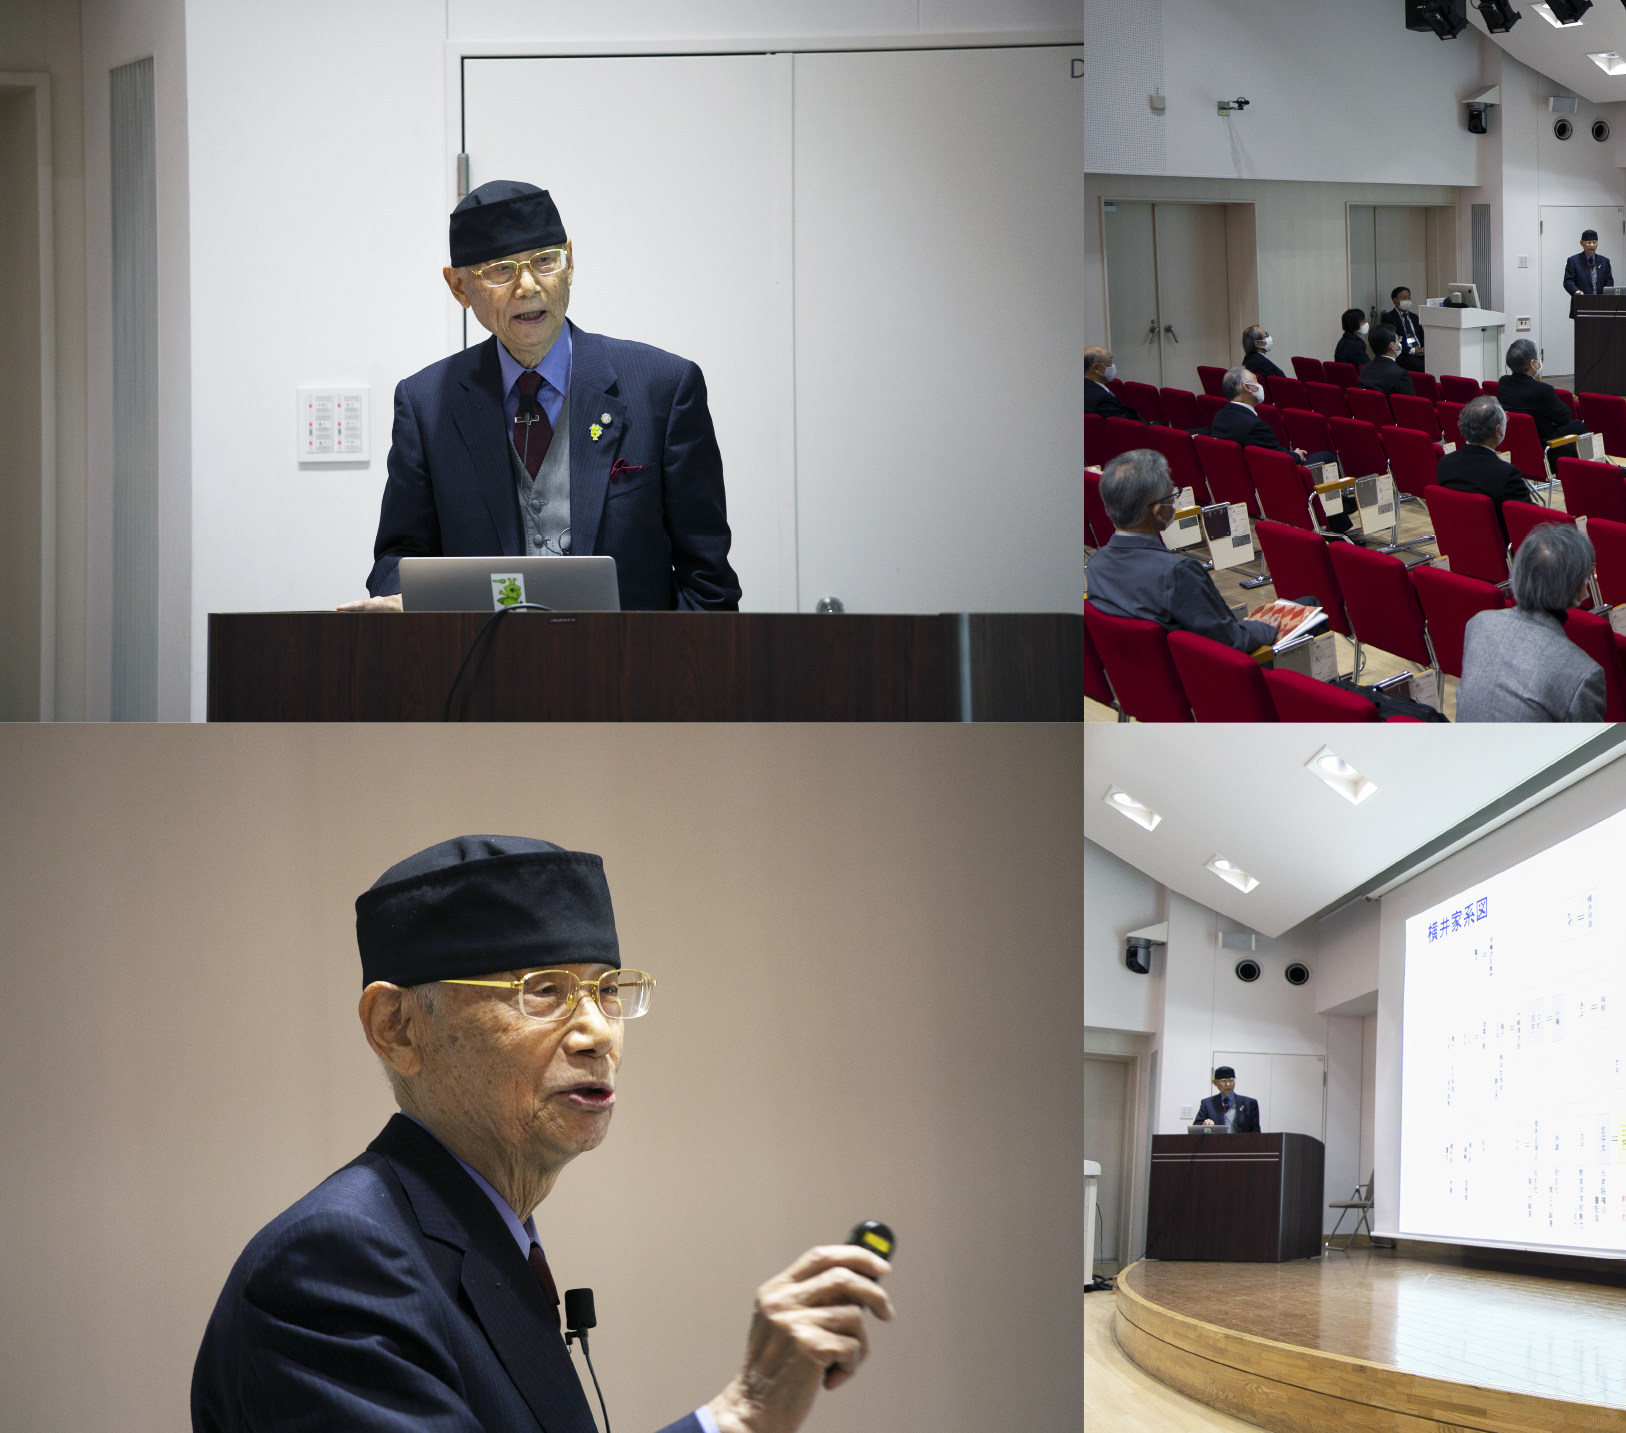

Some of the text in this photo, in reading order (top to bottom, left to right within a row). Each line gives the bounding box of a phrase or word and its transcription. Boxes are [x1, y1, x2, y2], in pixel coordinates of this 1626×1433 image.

[1428, 896, 1488, 943] 横井家系図
